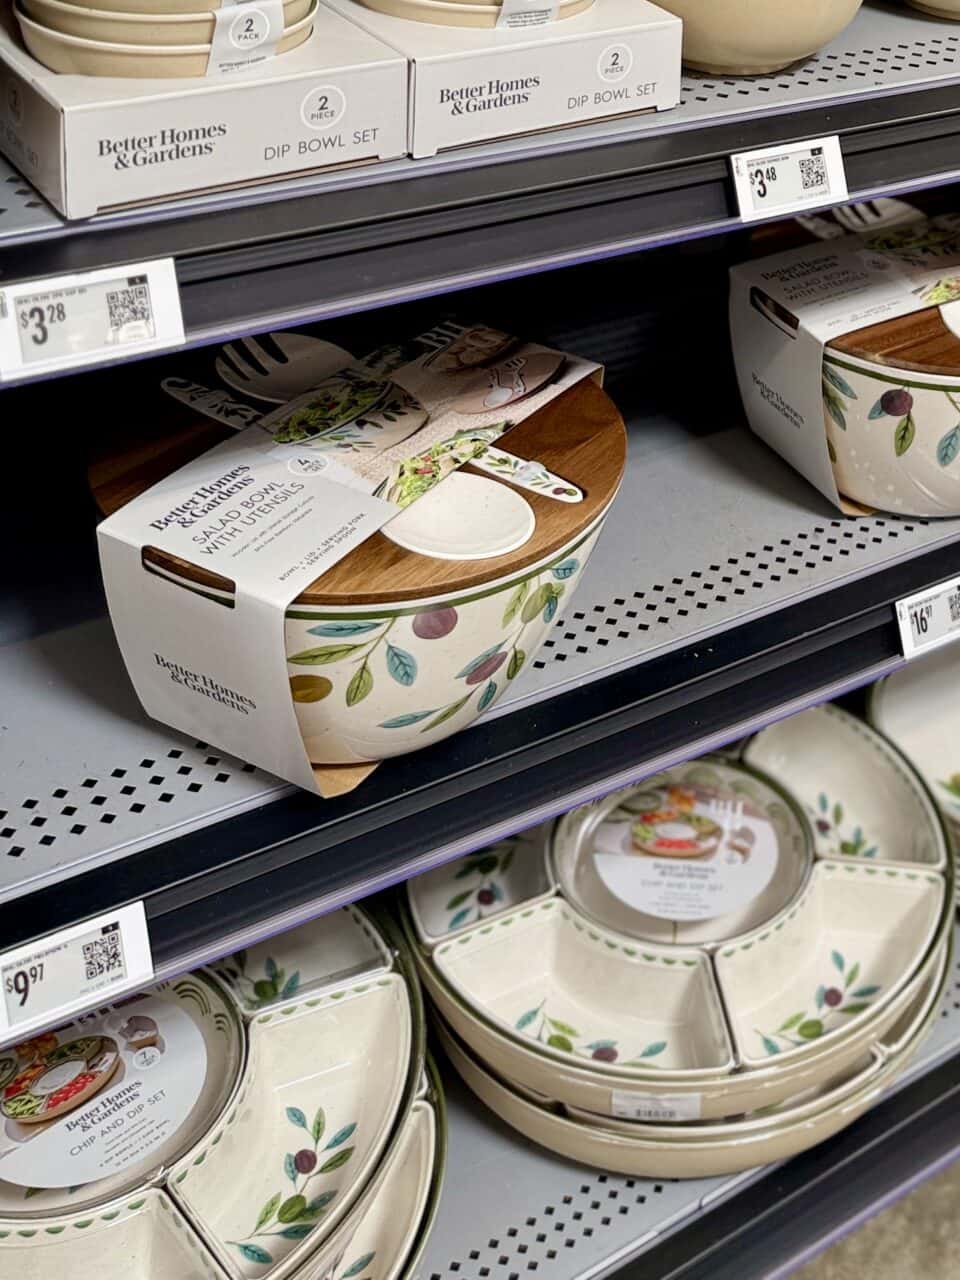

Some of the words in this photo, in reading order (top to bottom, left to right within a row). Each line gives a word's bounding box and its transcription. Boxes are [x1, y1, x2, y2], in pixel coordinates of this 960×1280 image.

[238, 33, 259, 41] PACK
[244, 18, 254, 32] 2
[604, 66, 624, 75] PIECE
[611, 52, 620, 66] 2
[318, 95, 329, 111] 2
[439, 84, 486, 104] Better
[488, 75, 540, 95] Homes
[567, 96, 589, 109] DIP
[593, 87, 631, 105] BOWL
[636, 82, 658, 97] SET
[310, 110, 335, 121] PIECE
[98, 133, 157, 158] Better
[160, 122, 227, 146] Homes
[264, 144, 291, 160] DIP
[298, 134, 345, 155] BOWL
[353, 128, 380, 145] SET
[149, 497, 200, 531] Better
[194, 464, 250, 500] Homes
[192, 509, 241, 545] SALAD
[240, 481, 285, 509] BOWL
[199, 526, 243, 555] WITH
[240, 482, 305, 526] UTENSILS
[154, 652, 199, 682] Better
[201, 675, 257, 710] Homes
[65, 1106, 101, 1132] Better
[100, 1081, 143, 1110] Homes
[69, 1134, 97, 1156] CHIP
[100, 1118, 125, 1137] AND
[126, 1103, 144, 1120] DIP
[146, 1088, 167, 1105] SET
